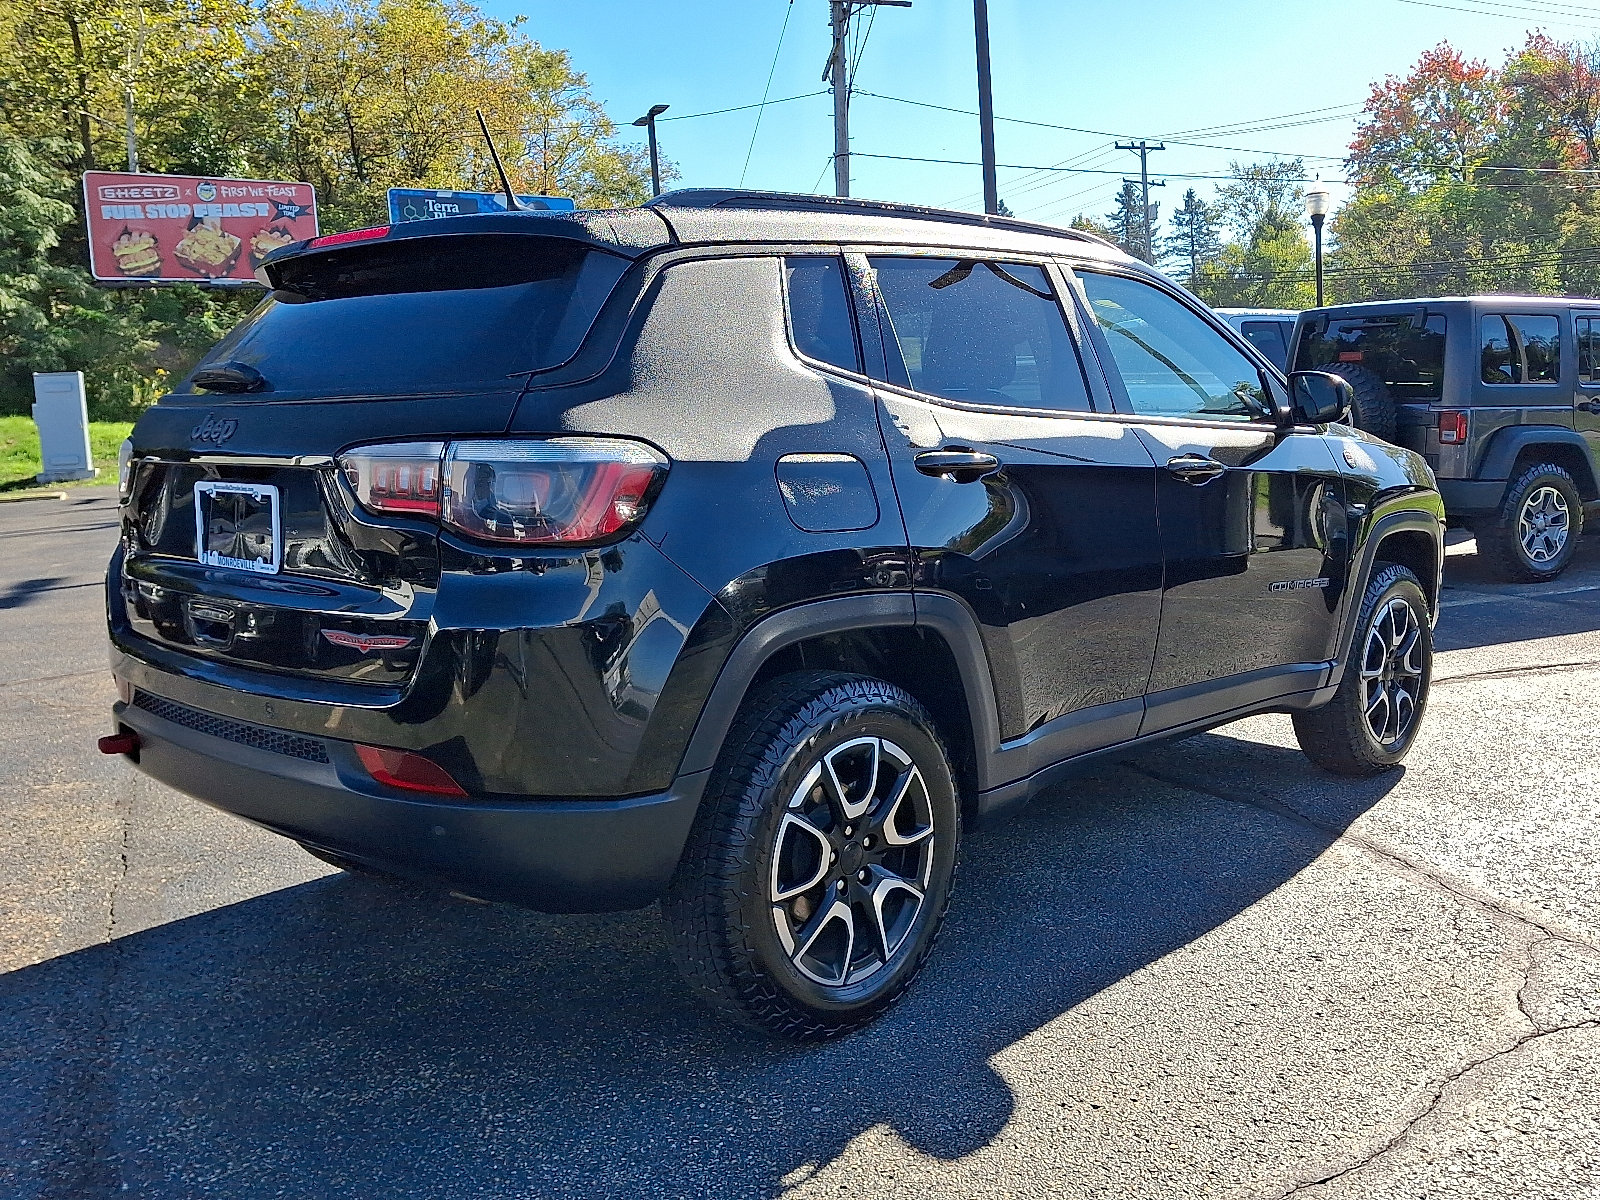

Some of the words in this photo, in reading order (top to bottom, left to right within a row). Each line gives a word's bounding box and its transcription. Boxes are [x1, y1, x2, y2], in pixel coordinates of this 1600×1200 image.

[104, 188, 175, 198] SHEETZ
[221, 185, 247, 198] FIRST
[248, 186, 264, 197] WE
[265, 185, 297, 197] FEAST
[101, 204, 145, 220] FUEL
[145, 203, 191, 219] STOP
[192, 203, 269, 217] FEAST
[424, 199, 460, 213] Terra
[190, 411, 239, 447] Jeep
[218, 556, 256, 571] MONROEVILLE
[1268, 578, 1330, 592] COMPASS
